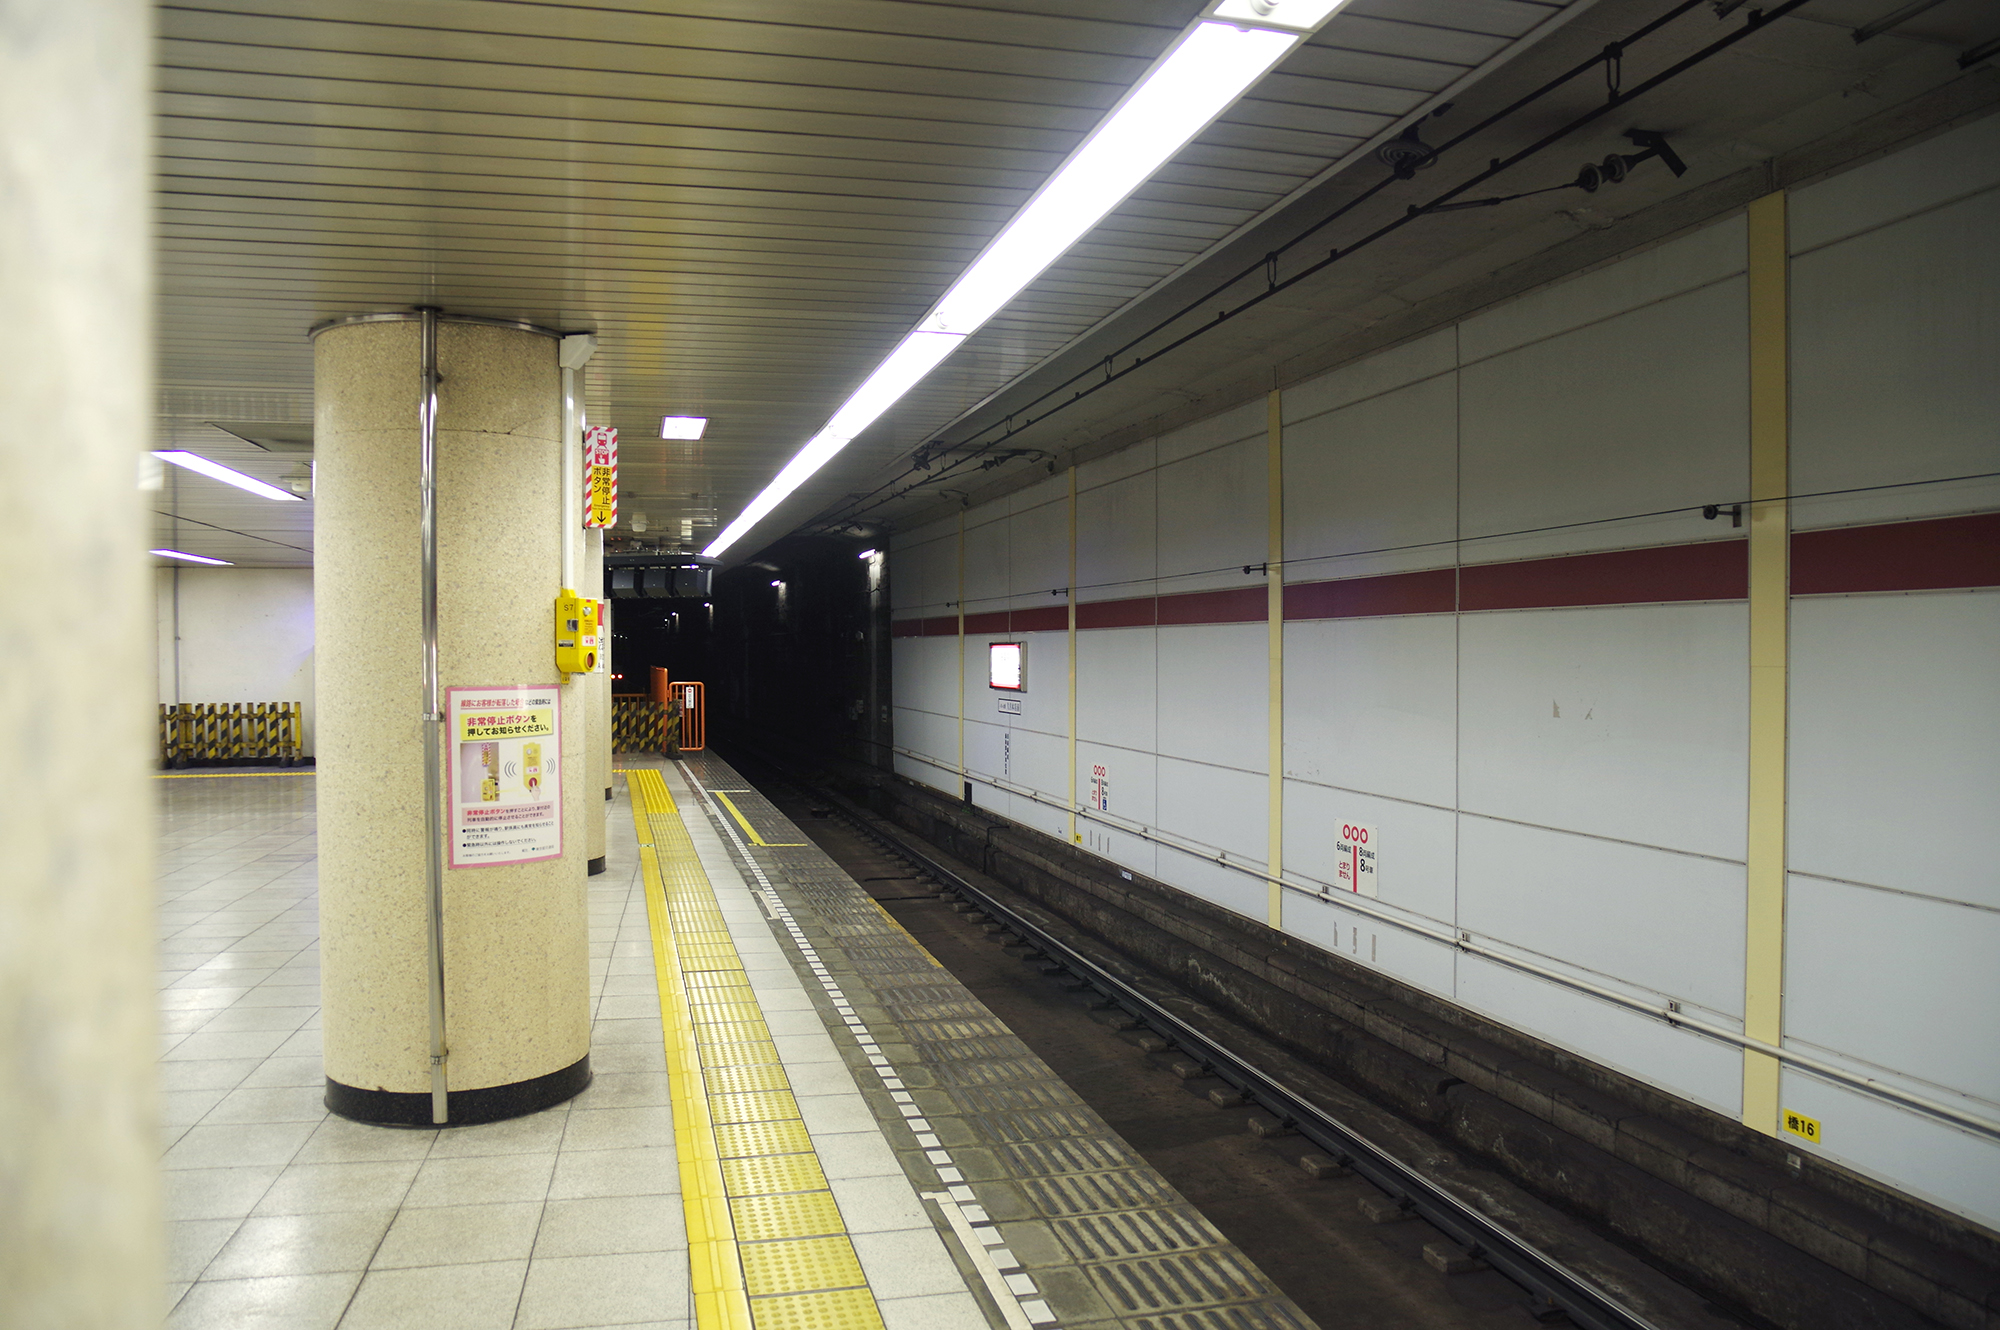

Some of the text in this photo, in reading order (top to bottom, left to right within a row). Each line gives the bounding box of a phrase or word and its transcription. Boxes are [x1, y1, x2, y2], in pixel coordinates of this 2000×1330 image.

[593, 467, 602, 493] ボタン
[602, 468, 611, 505] 非常停止
[466, 715, 537, 727] 非常停止ボタンを
[467, 724, 550, 737] 押してお知らせください。
[1338, 860, 1351, 871] とまり
[1359, 858, 1374, 874] 8号車
[1338, 870, 1351, 880] ません
[1787, 1114, 1815, 1137] 橋16
